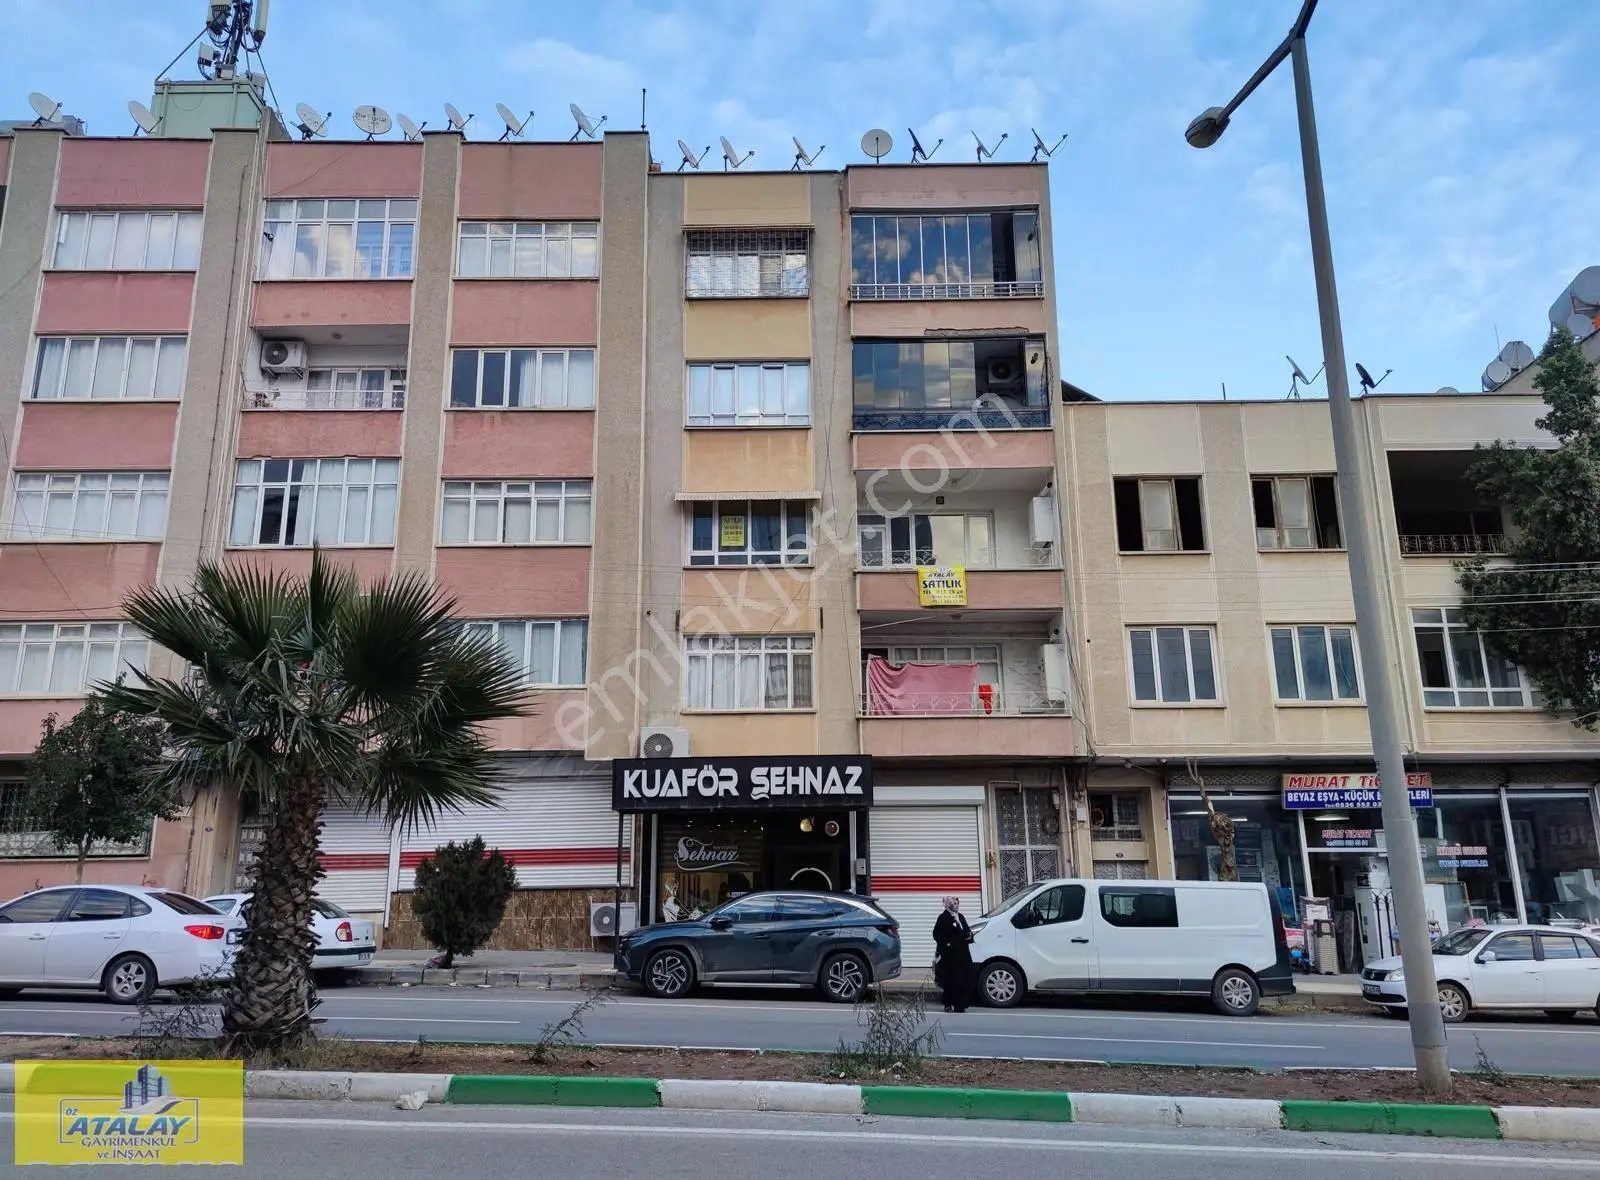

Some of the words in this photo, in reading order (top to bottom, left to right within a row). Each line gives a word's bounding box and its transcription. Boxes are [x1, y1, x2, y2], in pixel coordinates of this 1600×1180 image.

[922, 580, 962, 589] SATILIK
[623, 764, 740, 799] KUAFÖR
[750, 765, 863, 801] ŞEHNAZ
[1288, 775, 1350, 788] MURAT
[1287, 792, 1315, 802] BEYAZ
